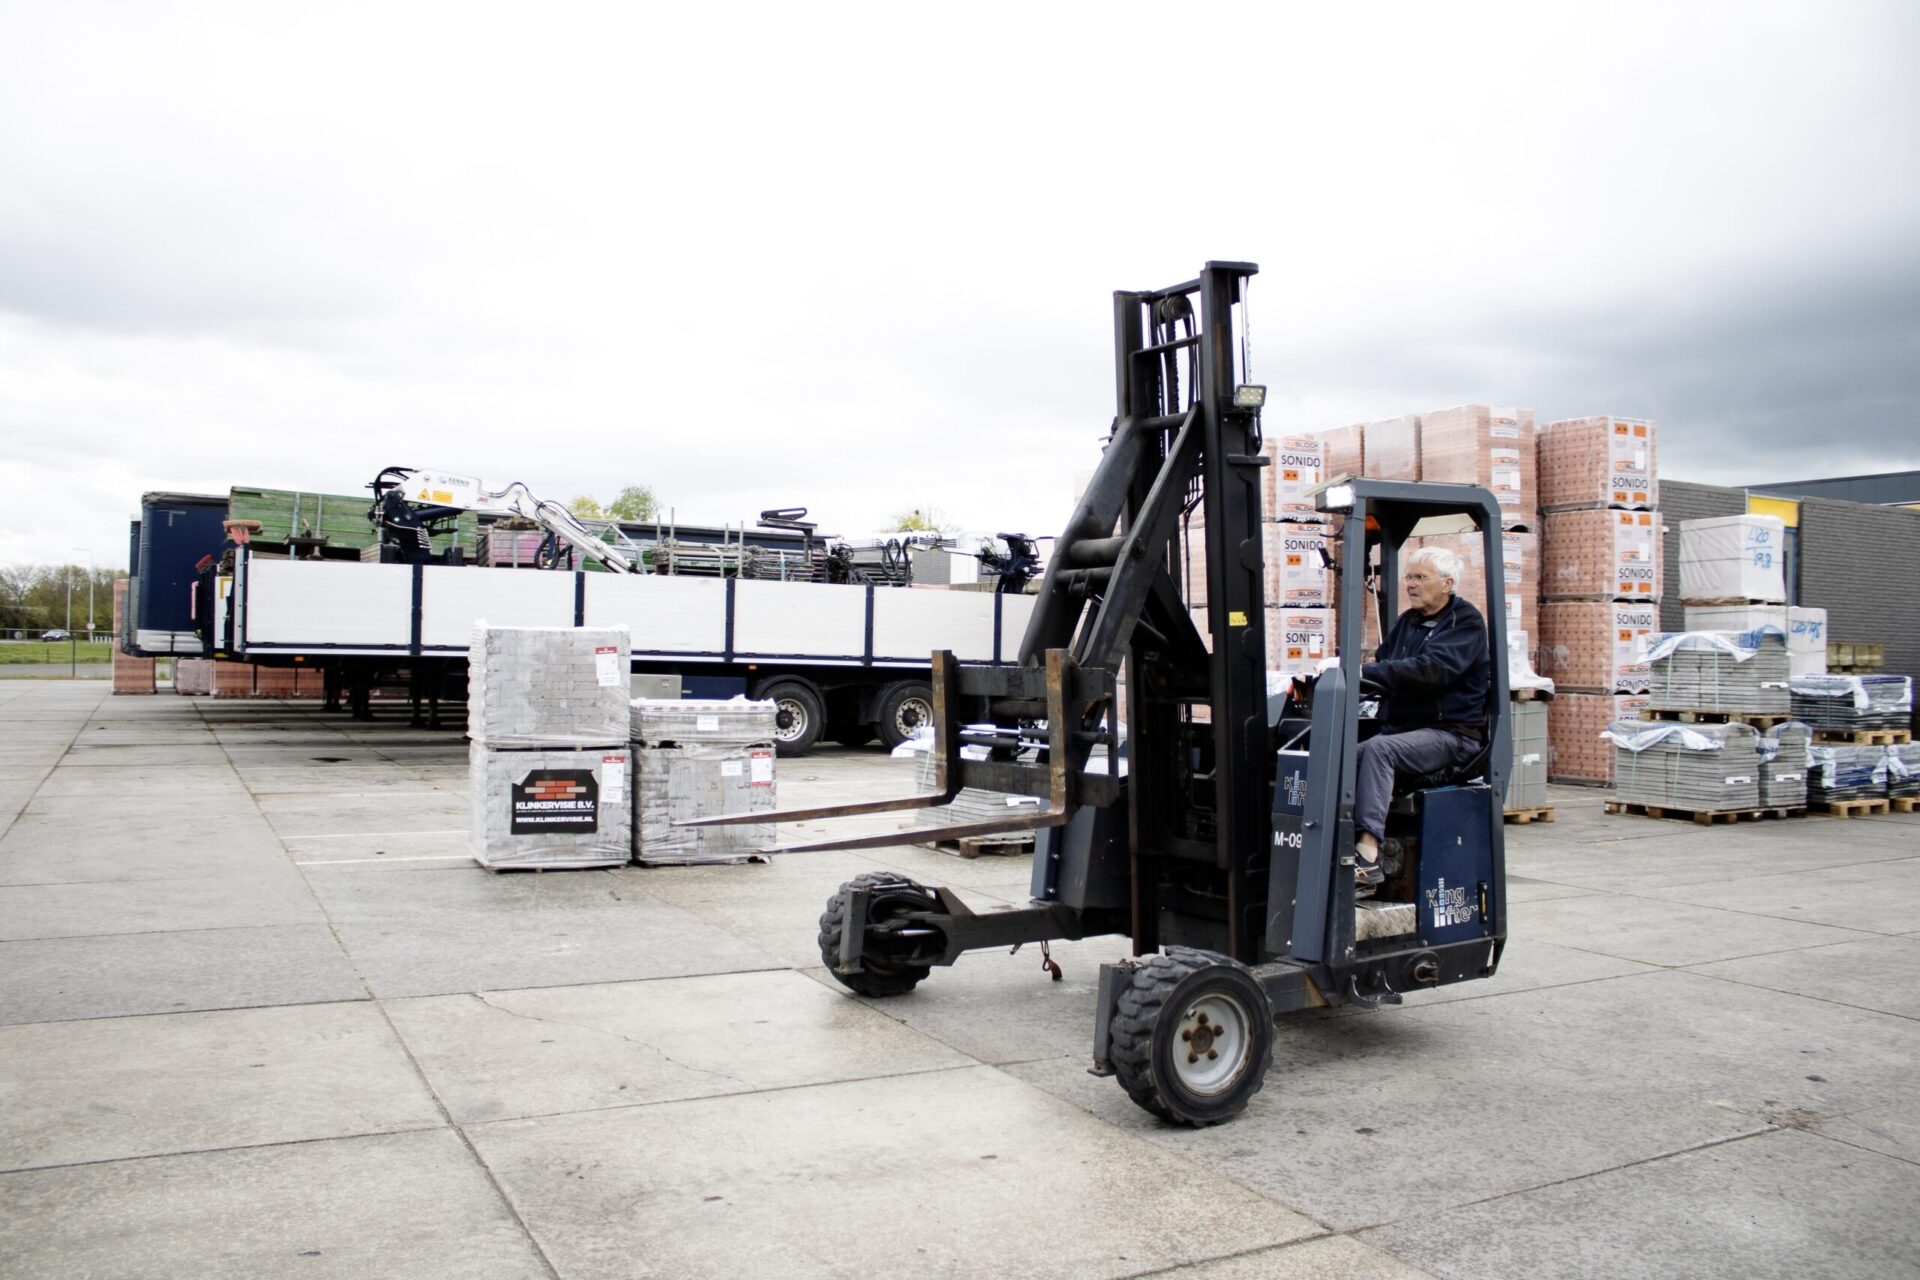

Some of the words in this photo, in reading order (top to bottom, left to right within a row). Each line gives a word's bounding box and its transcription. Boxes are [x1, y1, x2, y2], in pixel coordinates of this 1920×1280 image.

[1281, 455, 1320, 467] SONIDO
[1612, 477, 1648, 489] SONIDO
[1284, 539, 1324, 550] SONIDO
[1618, 567, 1654, 579] SONIDO
[1616, 613, 1653, 625] SONIDO
[1285, 632, 1325, 644] SONIO
[515, 801, 576, 810] KLINKERVISIE
[577, 800, 594, 809] B.V.
[1274, 831, 1303, 848] M-09
[1425, 877, 1465, 909] King
